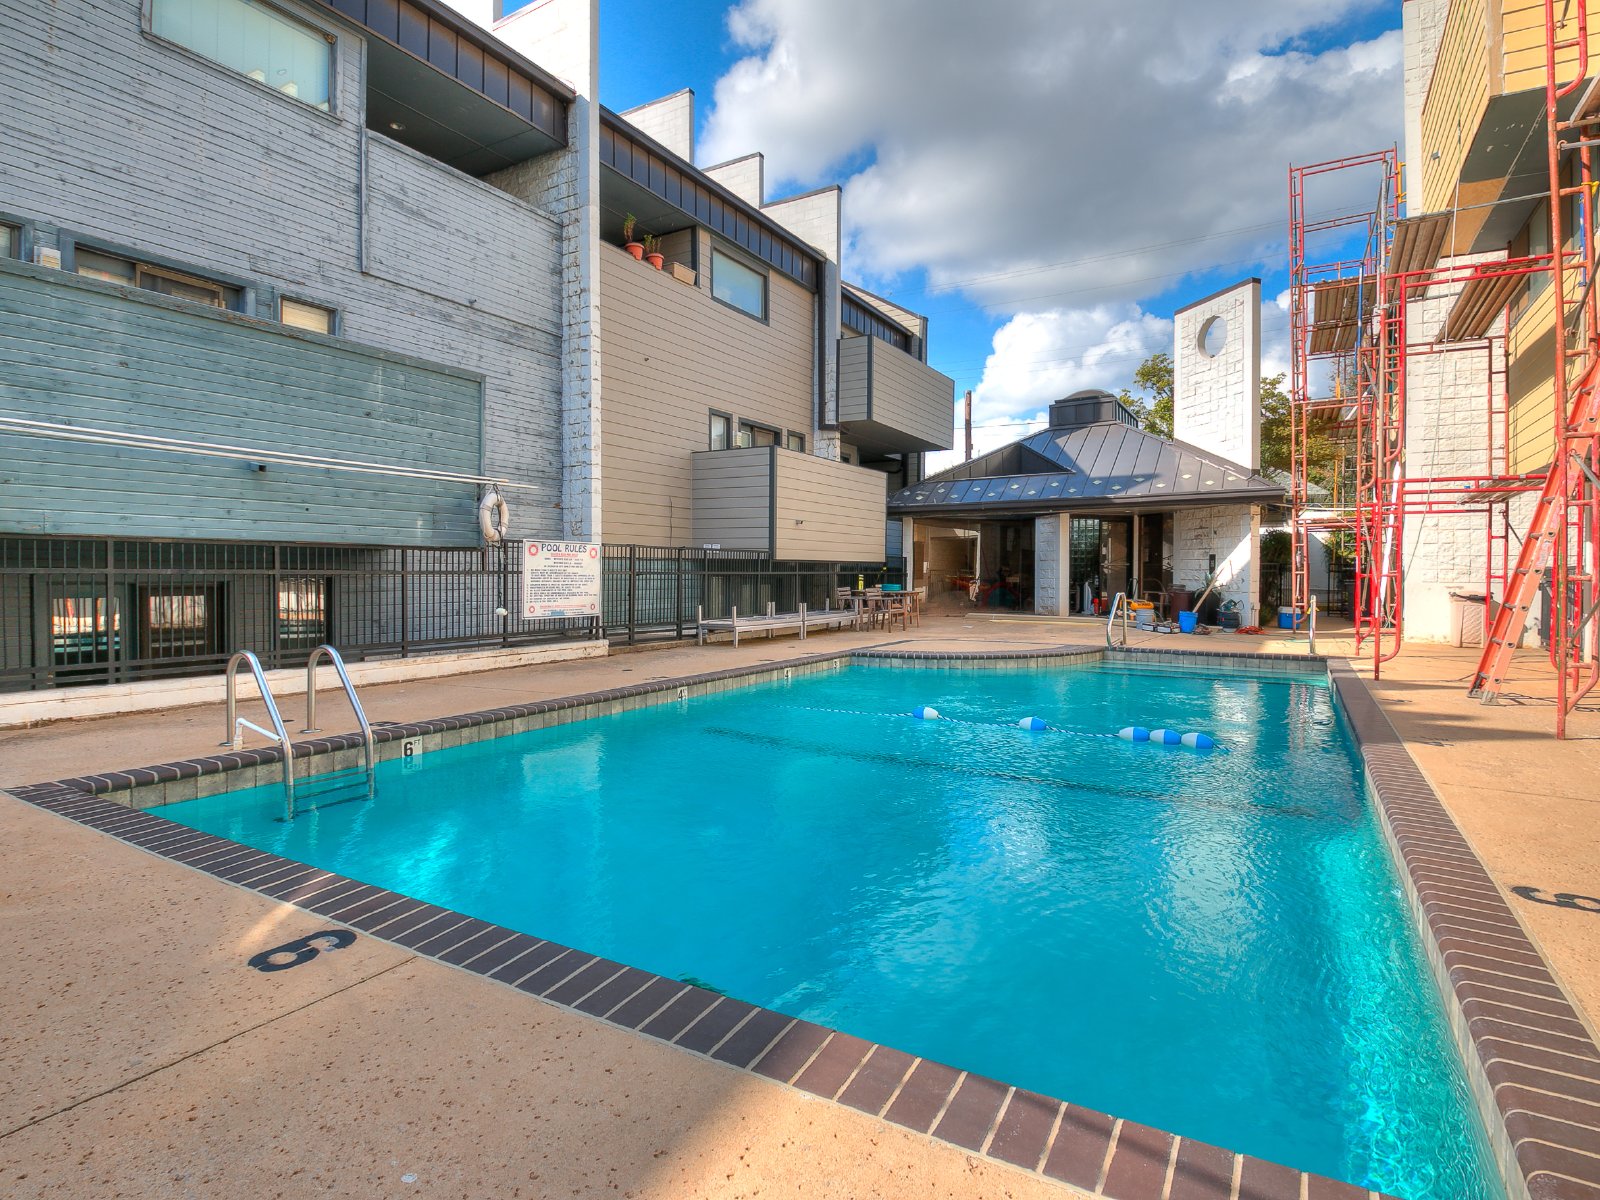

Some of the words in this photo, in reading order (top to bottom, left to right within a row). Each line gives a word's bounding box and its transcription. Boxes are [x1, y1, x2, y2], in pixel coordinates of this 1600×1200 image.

[541, 543, 562, 552] POOL
[564, 544, 588, 553] RULES
[403, 741, 413, 756] 6
[247, 929, 357, 972] 6
